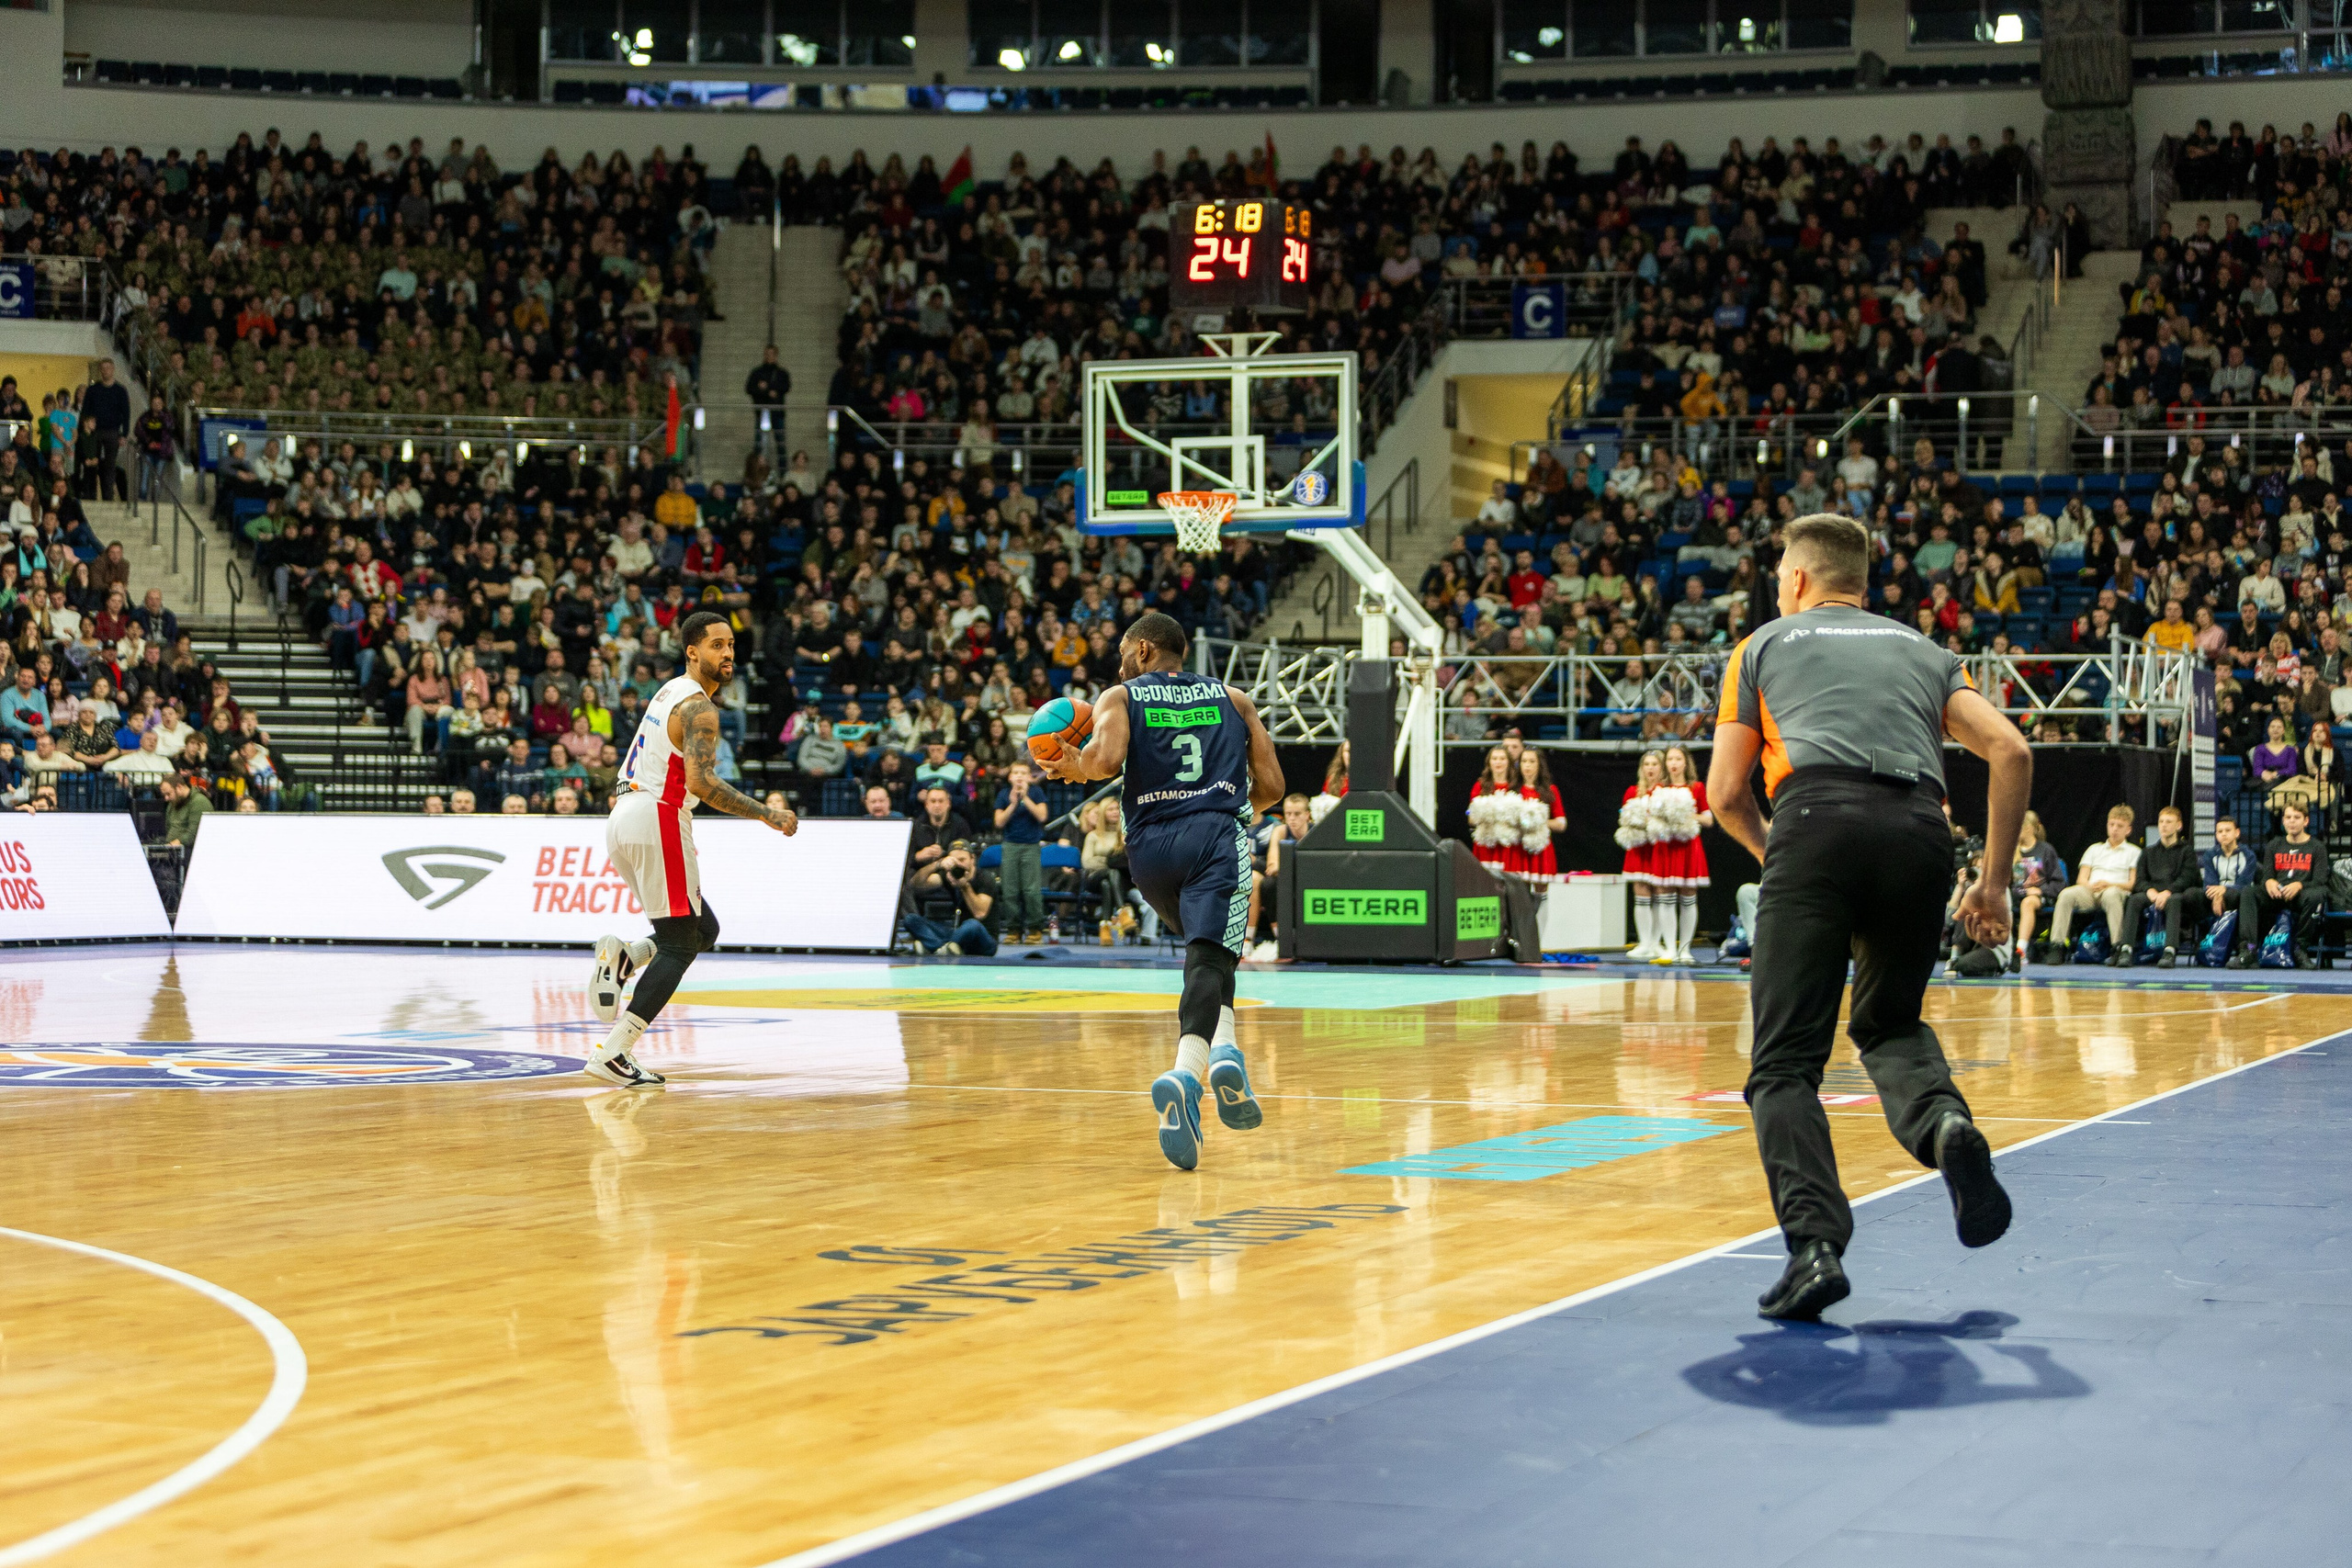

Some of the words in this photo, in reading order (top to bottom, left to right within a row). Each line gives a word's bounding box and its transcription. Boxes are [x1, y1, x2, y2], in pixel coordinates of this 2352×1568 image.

[1195, 203, 1263, 234] 6:18
[1189, 237, 1250, 282] 24
[1283, 238, 1308, 283] 24
[1131, 682, 1226, 705] OGUNGBEMI
[1149, 710, 1216, 723] BETERA
[1171, 733, 1204, 782] 3
[1136, 780, 1237, 806] BELTAMOZHSVICE
[1351, 814, 1379, 824] BET
[0, 840, 32, 874] US
[2274, 852, 2312, 863] BULLS
[0, 877, 45, 910] ORS
[1311, 897, 1419, 917] BETERA
[1459, 906, 1498, 931] BETERA
[675, 1201, 1411, 1348] ЗАРУБЕЖНЕФТЬ
